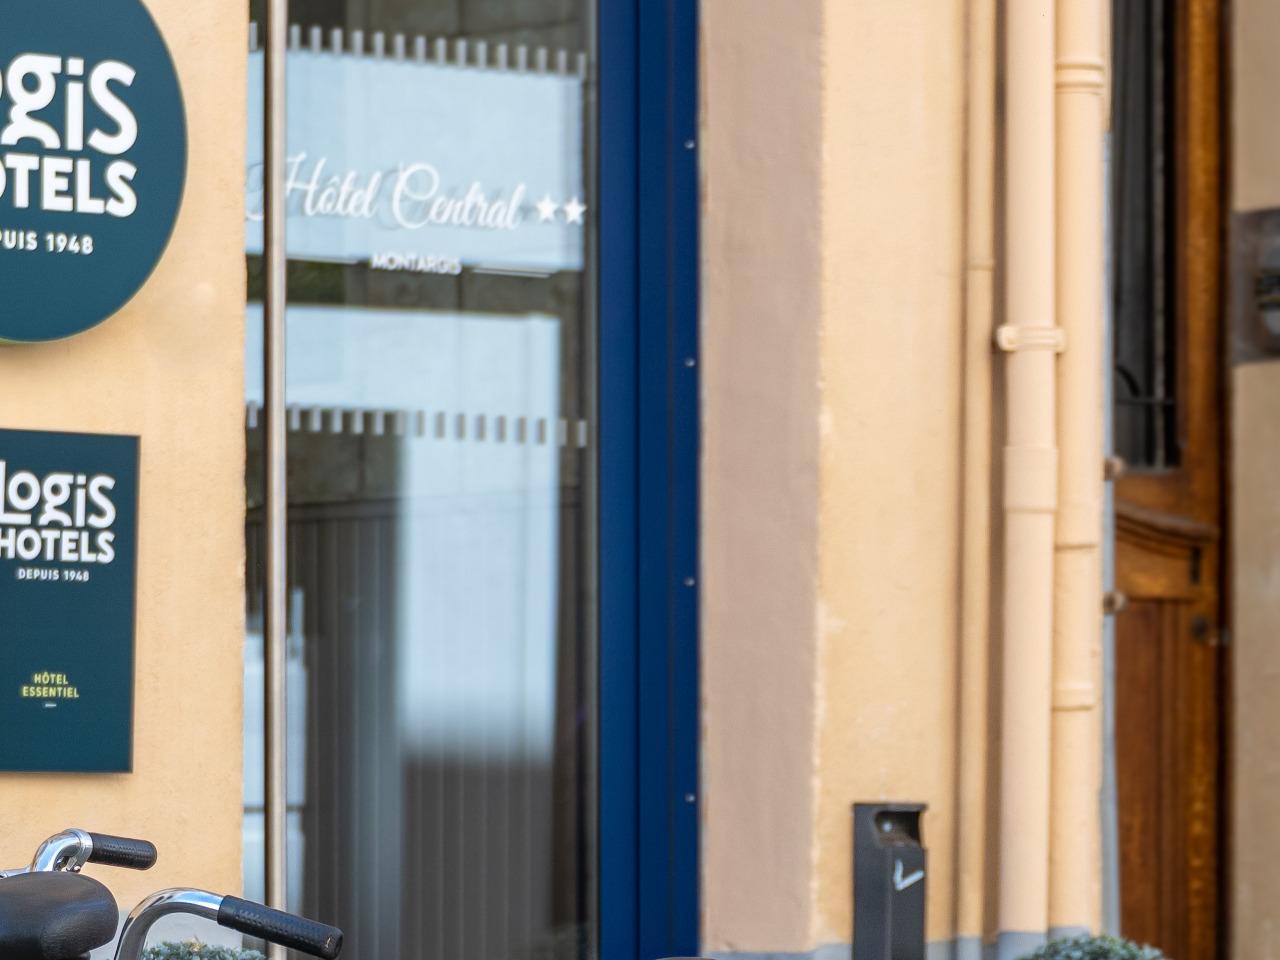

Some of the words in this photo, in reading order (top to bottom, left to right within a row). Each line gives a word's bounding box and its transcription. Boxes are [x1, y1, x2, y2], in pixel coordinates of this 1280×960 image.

[285, 151, 383, 219] Hôtel
[392, 162, 526, 231] Central
[46, 232, 95, 256] 1948
[17, 567, 60, 581] DEPUIS
[63, 569, 90, 583] 1948
[33, 671, 70, 686] HÔTEL
[21, 685, 80, 699] ESSENTIEL
